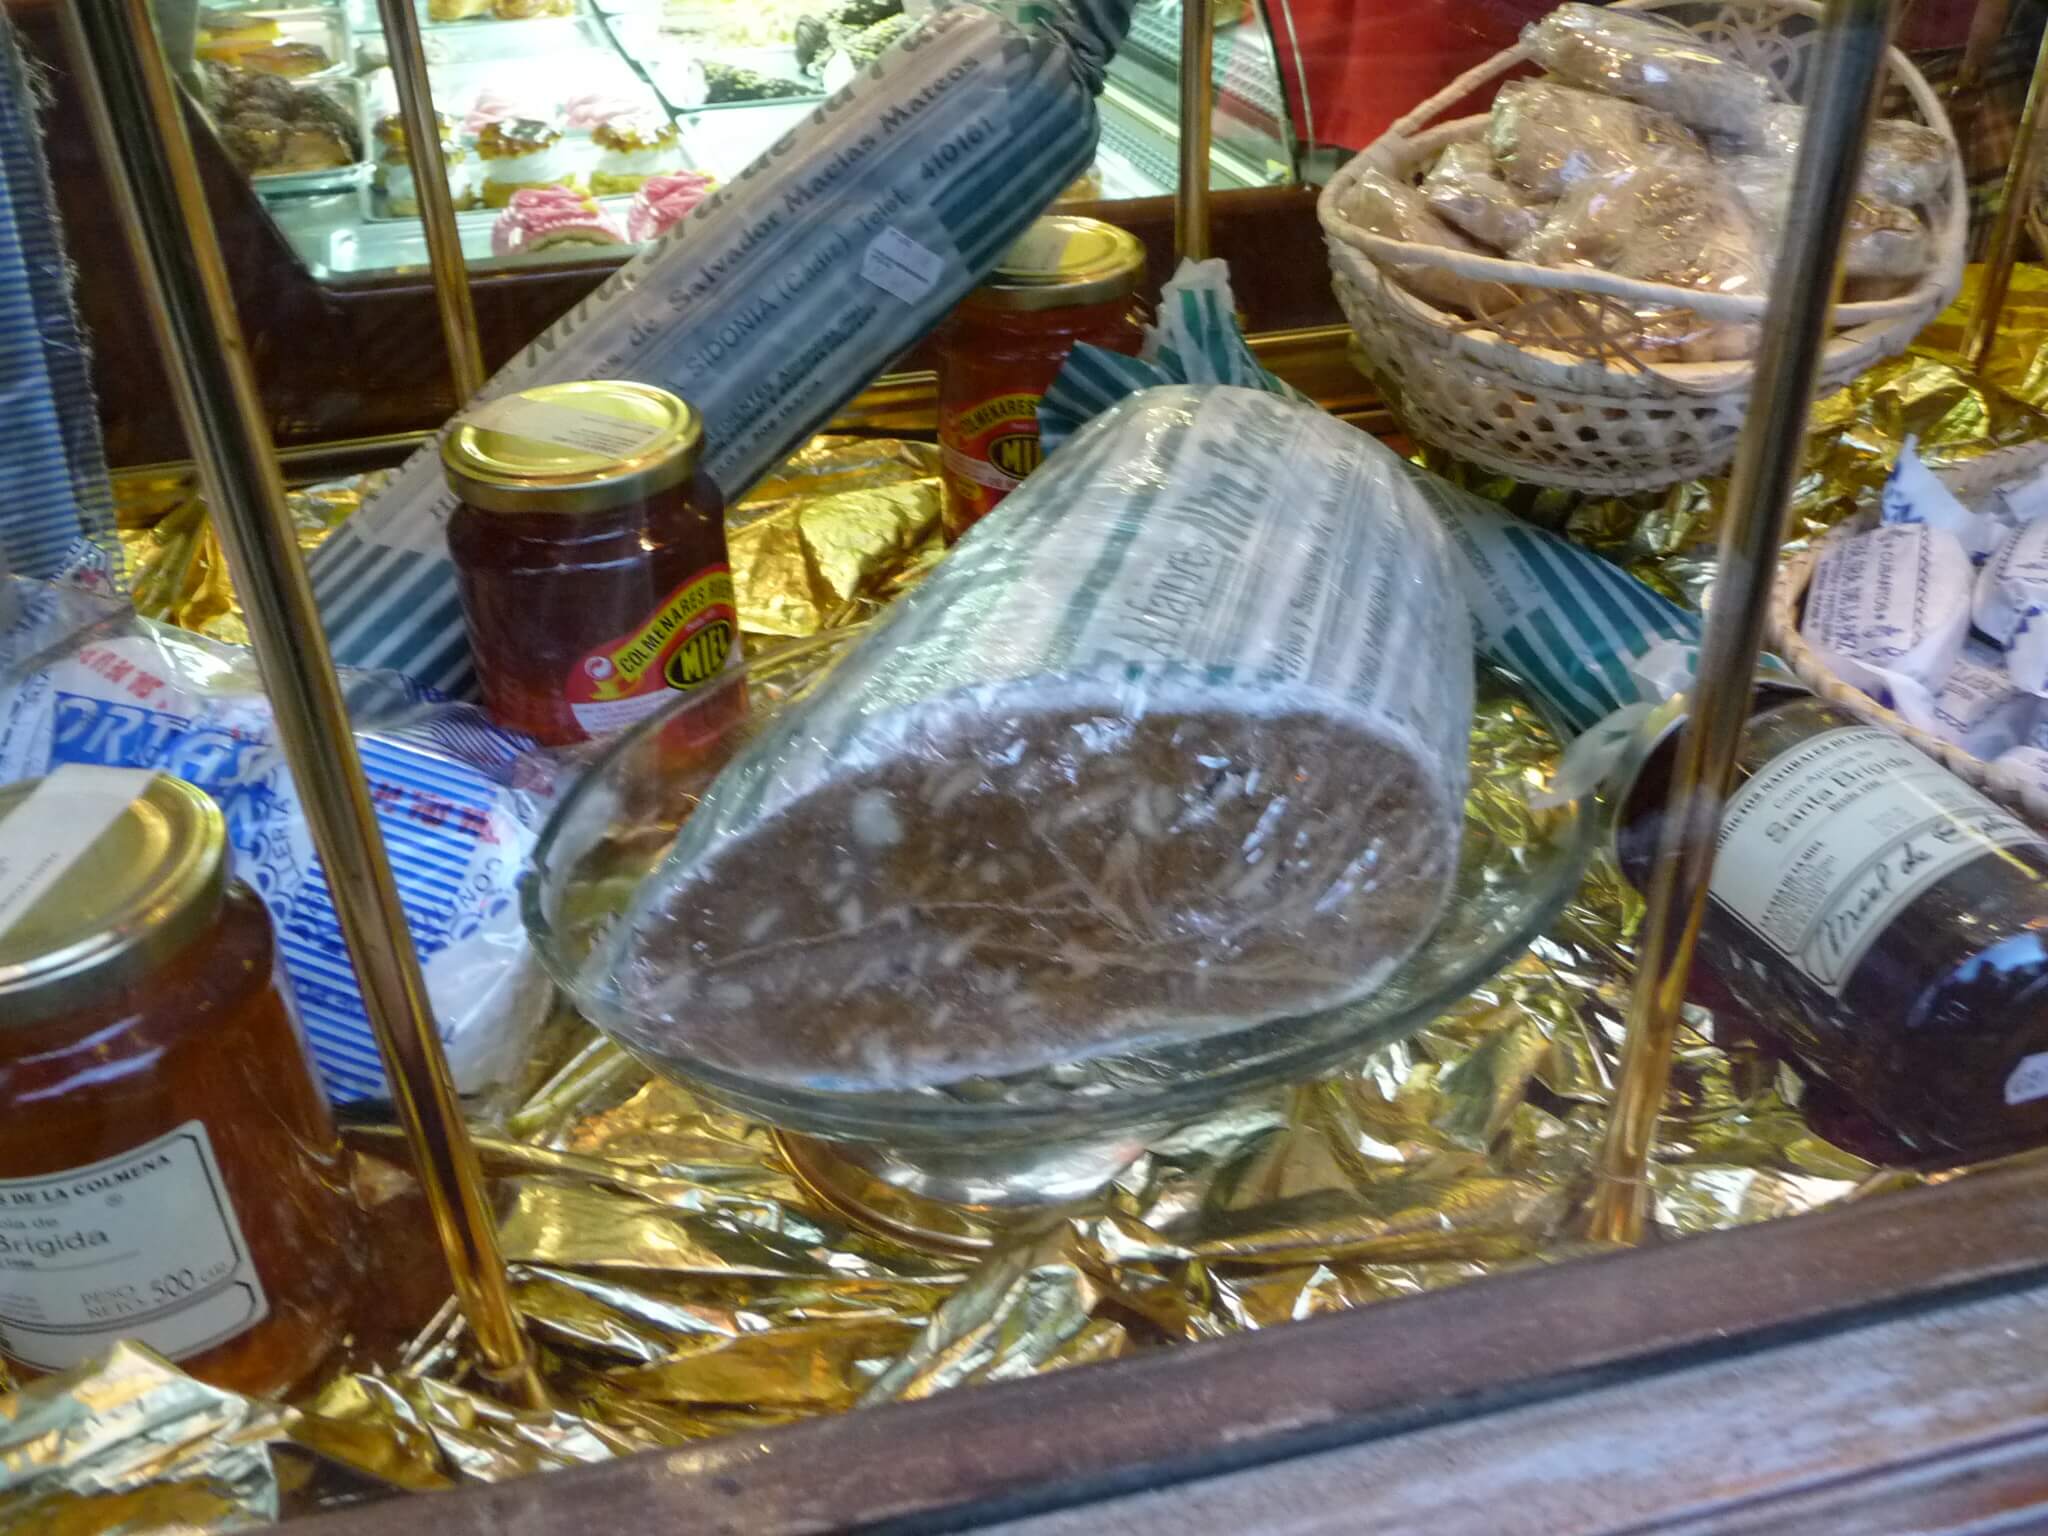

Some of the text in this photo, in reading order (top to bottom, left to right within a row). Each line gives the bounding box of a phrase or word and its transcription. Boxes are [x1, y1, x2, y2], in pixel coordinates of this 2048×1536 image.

[630, 319, 659, 348] de
[666, 213, 780, 314] Salvador
[878, 57, 980, 135] Mateos
[686, 296, 780, 378] SIDONIA
[619, 585, 706, 673] COLMENARES
[1765, 788, 1834, 844] Santa
[43, 1185, 69, 1203] LA
[72, 1153, 172, 1198] COLMENA
[149, 1267, 196, 1305] 500
